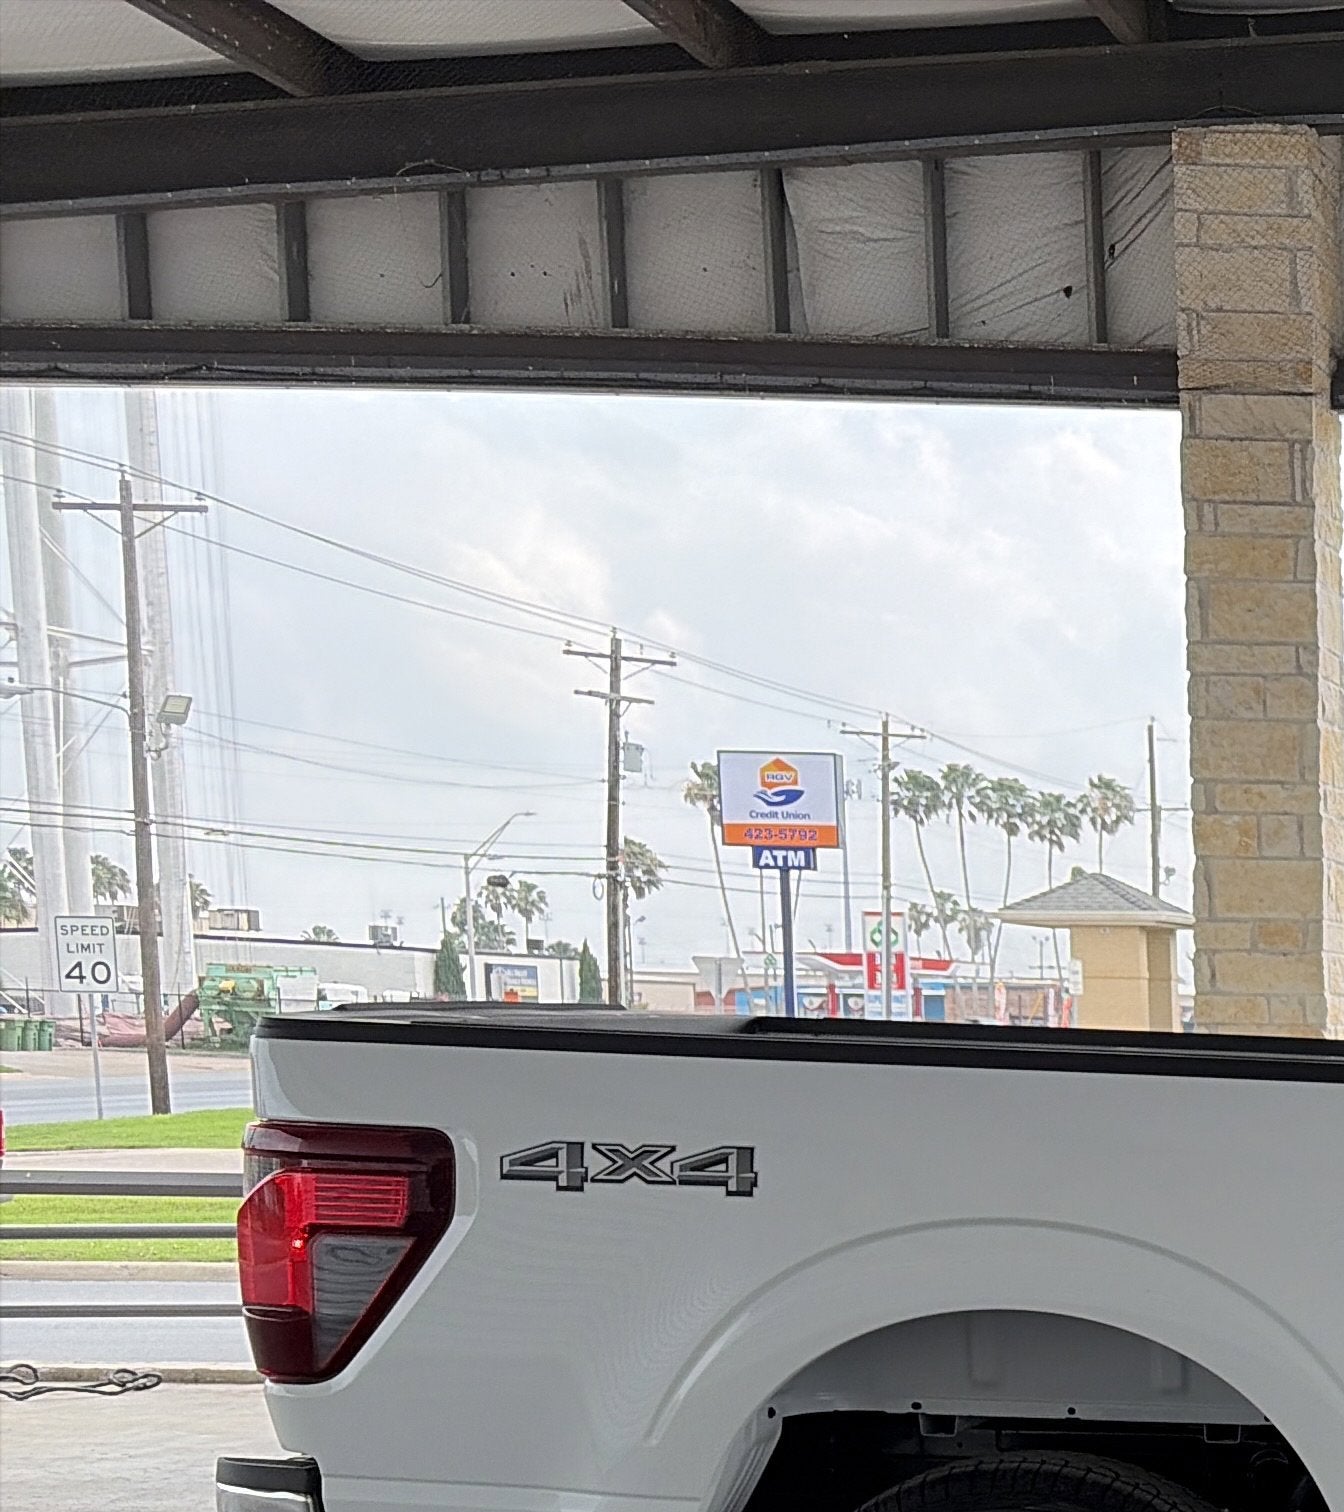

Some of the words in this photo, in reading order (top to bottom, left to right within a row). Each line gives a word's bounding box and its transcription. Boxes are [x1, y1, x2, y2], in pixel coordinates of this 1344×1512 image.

[766, 773, 792, 781] RGV
[749, 810, 779, 819] Credit
[781, 811, 811, 820] Union
[744, 828, 817, 841] 423-5792
[759, 849, 805, 867] ATM
[60, 925, 110, 936] SPEED
[66, 943, 105, 954] LIMIT
[65, 961, 112, 985] 40
